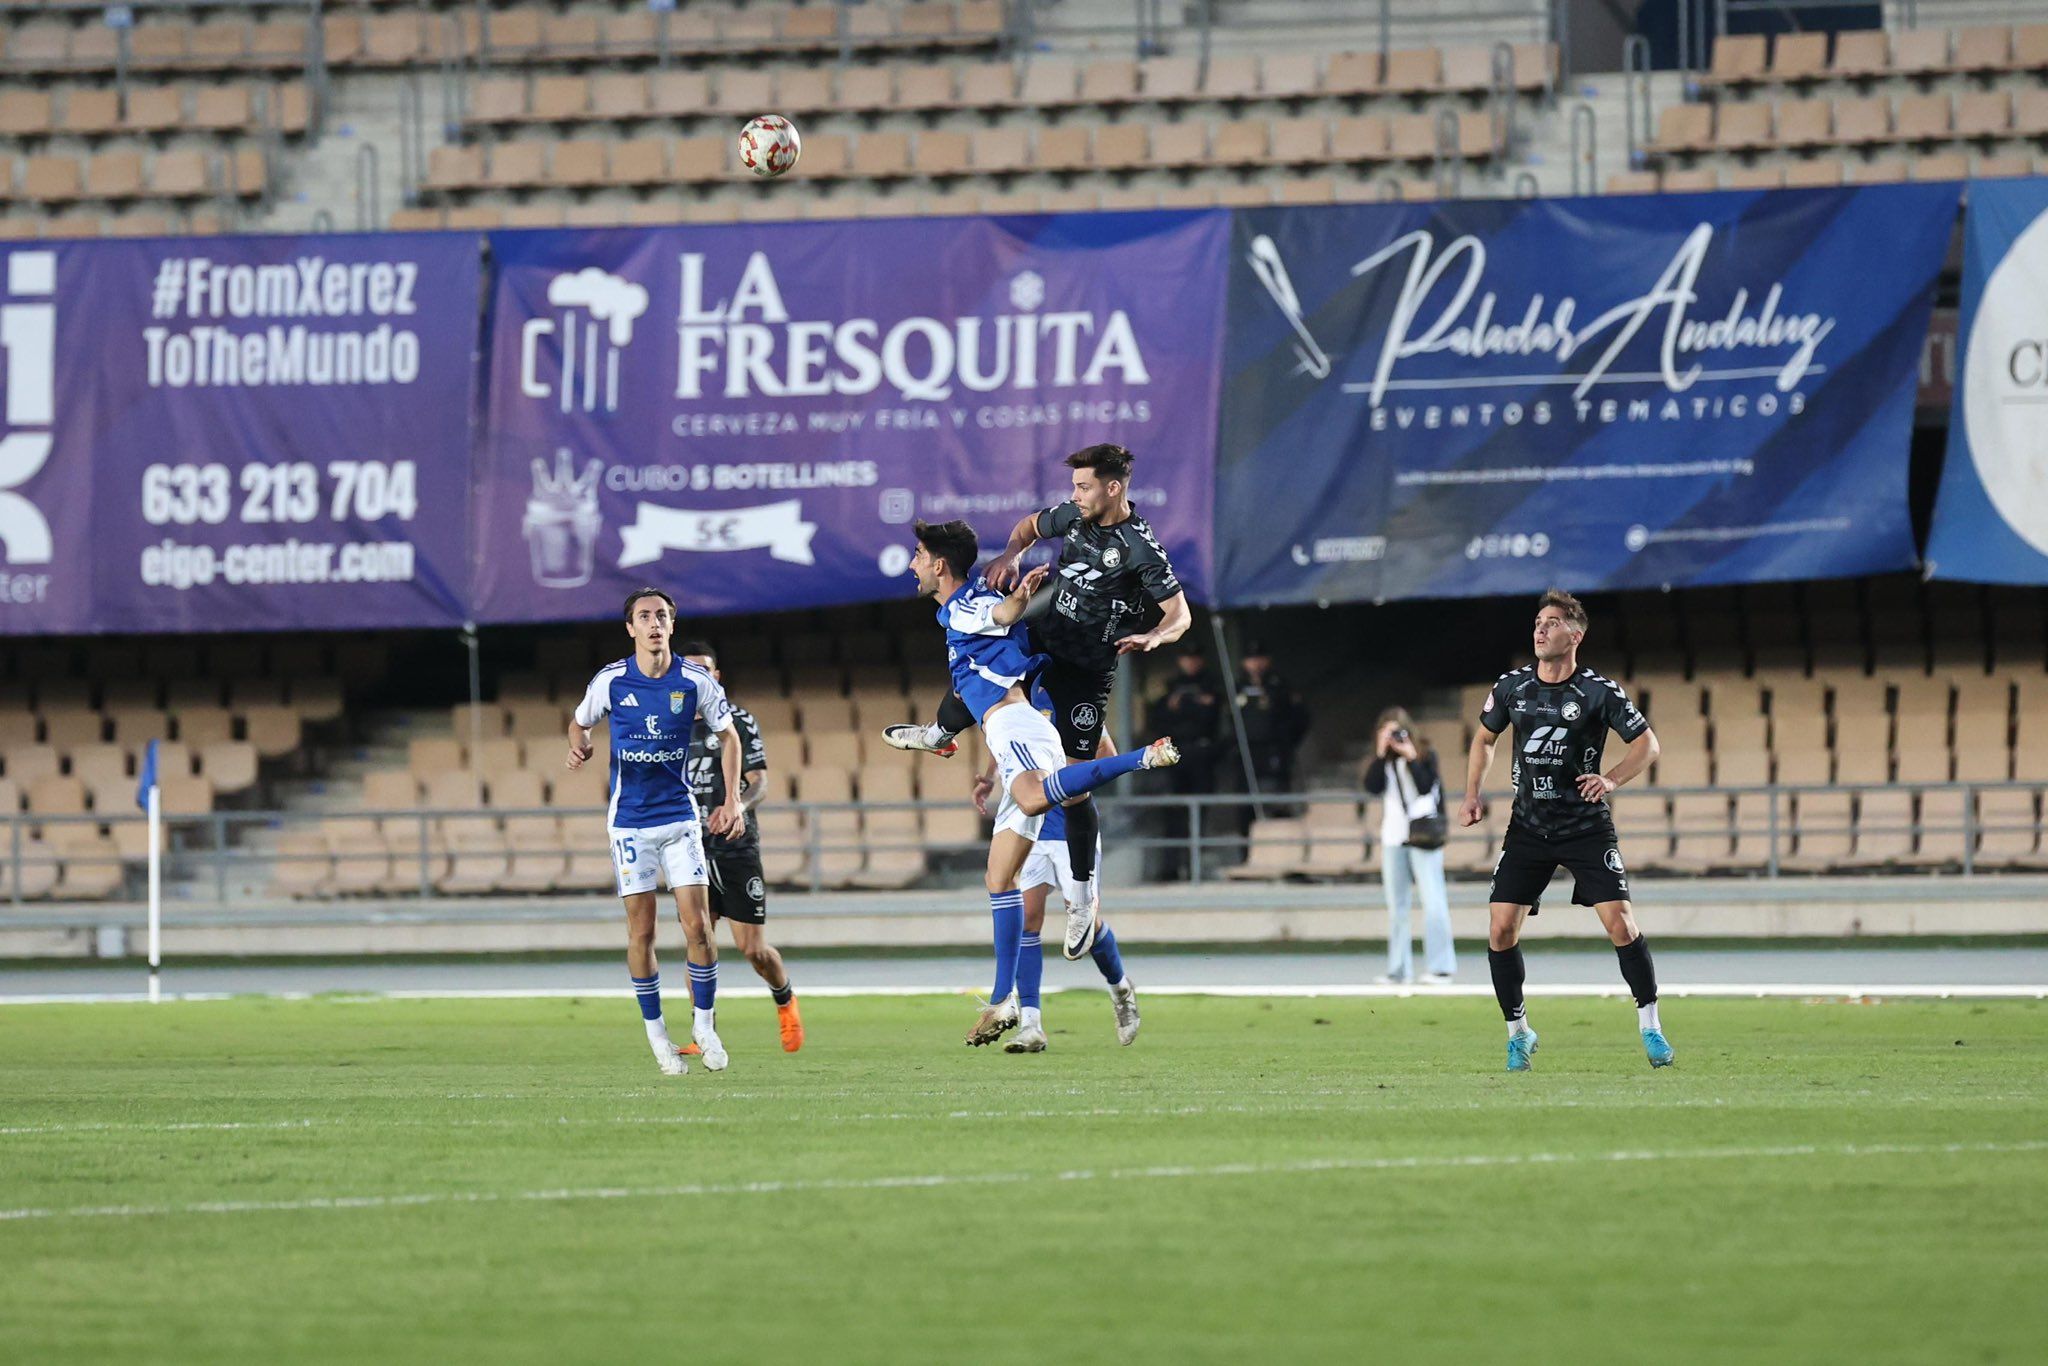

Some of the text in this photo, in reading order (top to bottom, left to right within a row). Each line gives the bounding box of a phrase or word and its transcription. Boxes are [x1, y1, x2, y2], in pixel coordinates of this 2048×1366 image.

[152, 255, 418, 319] #FromXerez
[676, 251, 790, 323] LA
[142, 322, 420, 388] ToTheMundo
[675, 309, 1151, 402] FRESQUITA
[2008, 338, 2048, 388] C
[671, 410, 800, 438] CERVEZA
[976, 404, 1063, 430] COSAS
[1369, 401, 1552, 431] EVENTOS
[141, 459, 419, 525] 633 213 704
[605, 464, 690, 492] CUBO
[712, 460, 879, 490] BOTELLINES
[1073, 576, 1095, 590] Air
[1524, 756, 1564, 766] oneair.es
[1540, 740, 1568, 756] Air
[616, 836, 637, 865] 15
